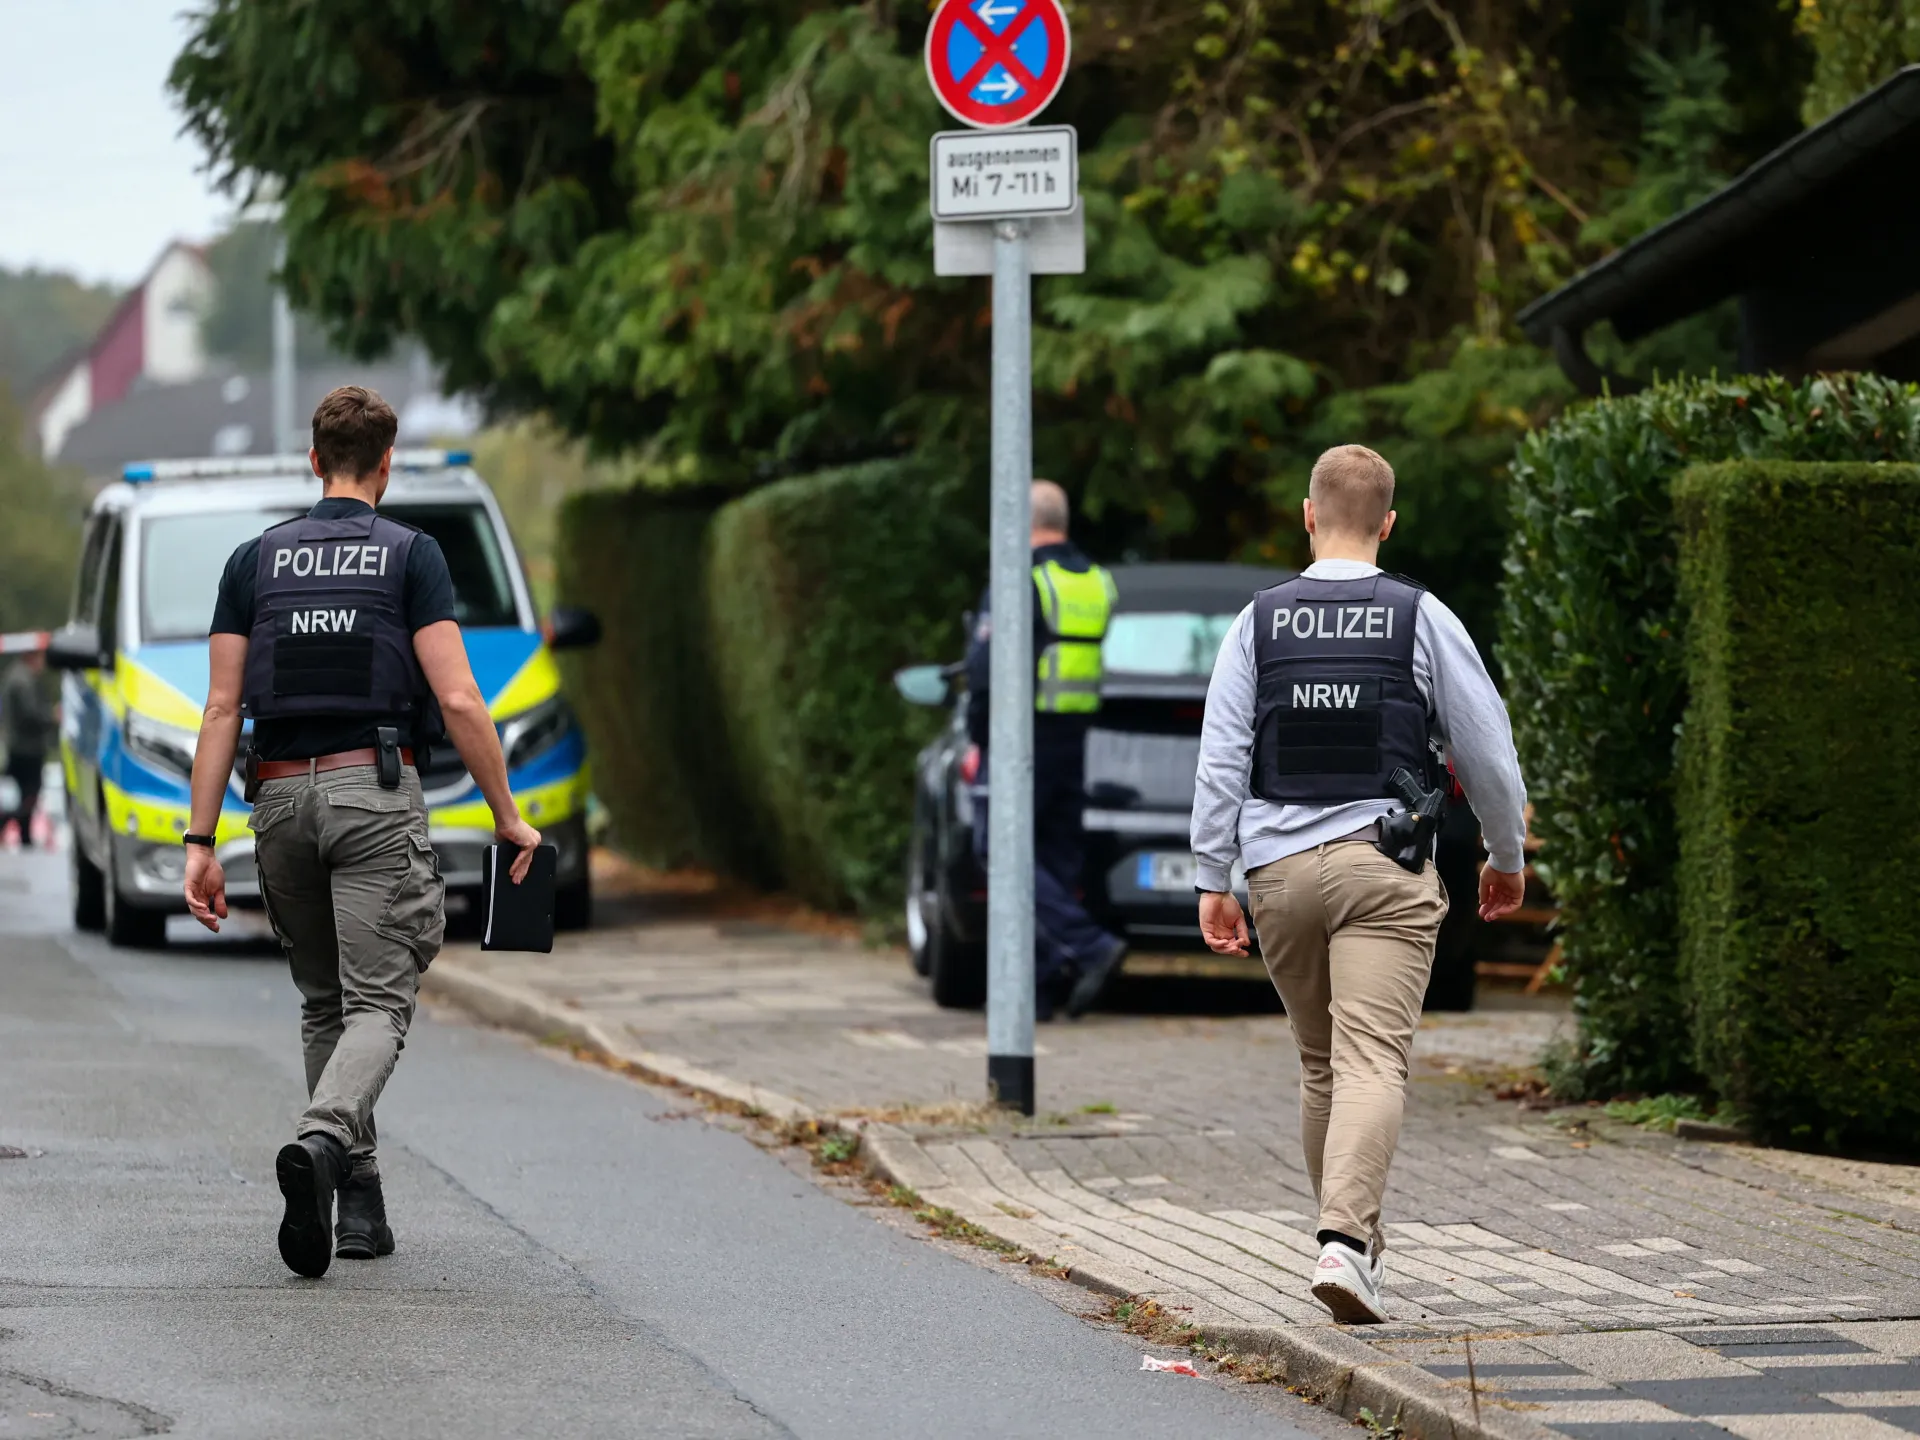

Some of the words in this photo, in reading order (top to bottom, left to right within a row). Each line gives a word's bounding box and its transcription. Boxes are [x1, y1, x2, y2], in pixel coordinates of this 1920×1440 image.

[948, 147, 1060, 171] ausgenommen
[952, 174, 979, 197] Mi
[1044, 171, 1056, 193] h
[273, 545, 388, 578] POLIZEI
[291, 609, 357, 634] NRW
[1272, 606, 1394, 640] POLIZEI
[1292, 683, 1361, 709] NRW
